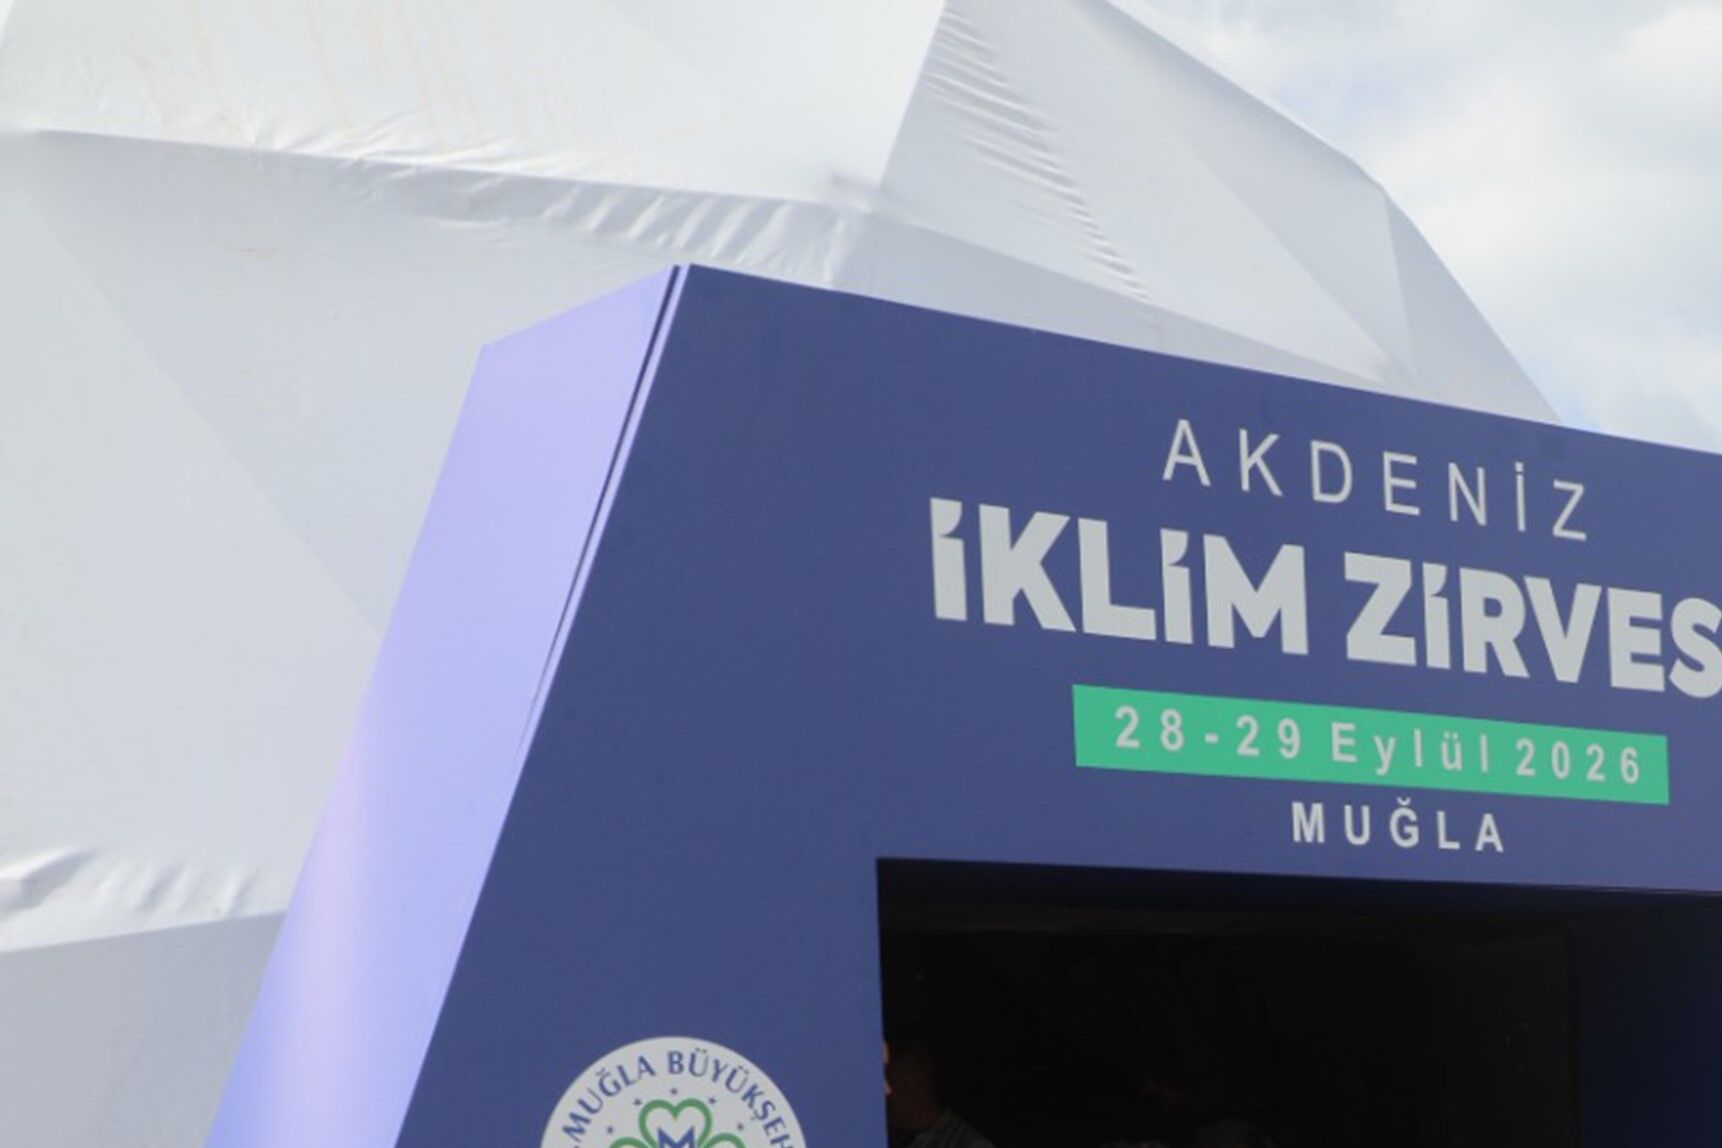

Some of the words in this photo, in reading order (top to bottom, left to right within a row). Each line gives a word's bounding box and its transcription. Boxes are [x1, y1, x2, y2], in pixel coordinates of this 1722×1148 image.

[1162, 418, 1589, 540] AKDENİZ
[929, 497, 1310, 656] İKLİM
[1114, 705, 1302, 760] 28-29
[1330, 721, 1490, 776] Eylül
[1515, 739, 1641, 785] 2026
[1291, 796, 1505, 853] MUĞLA
